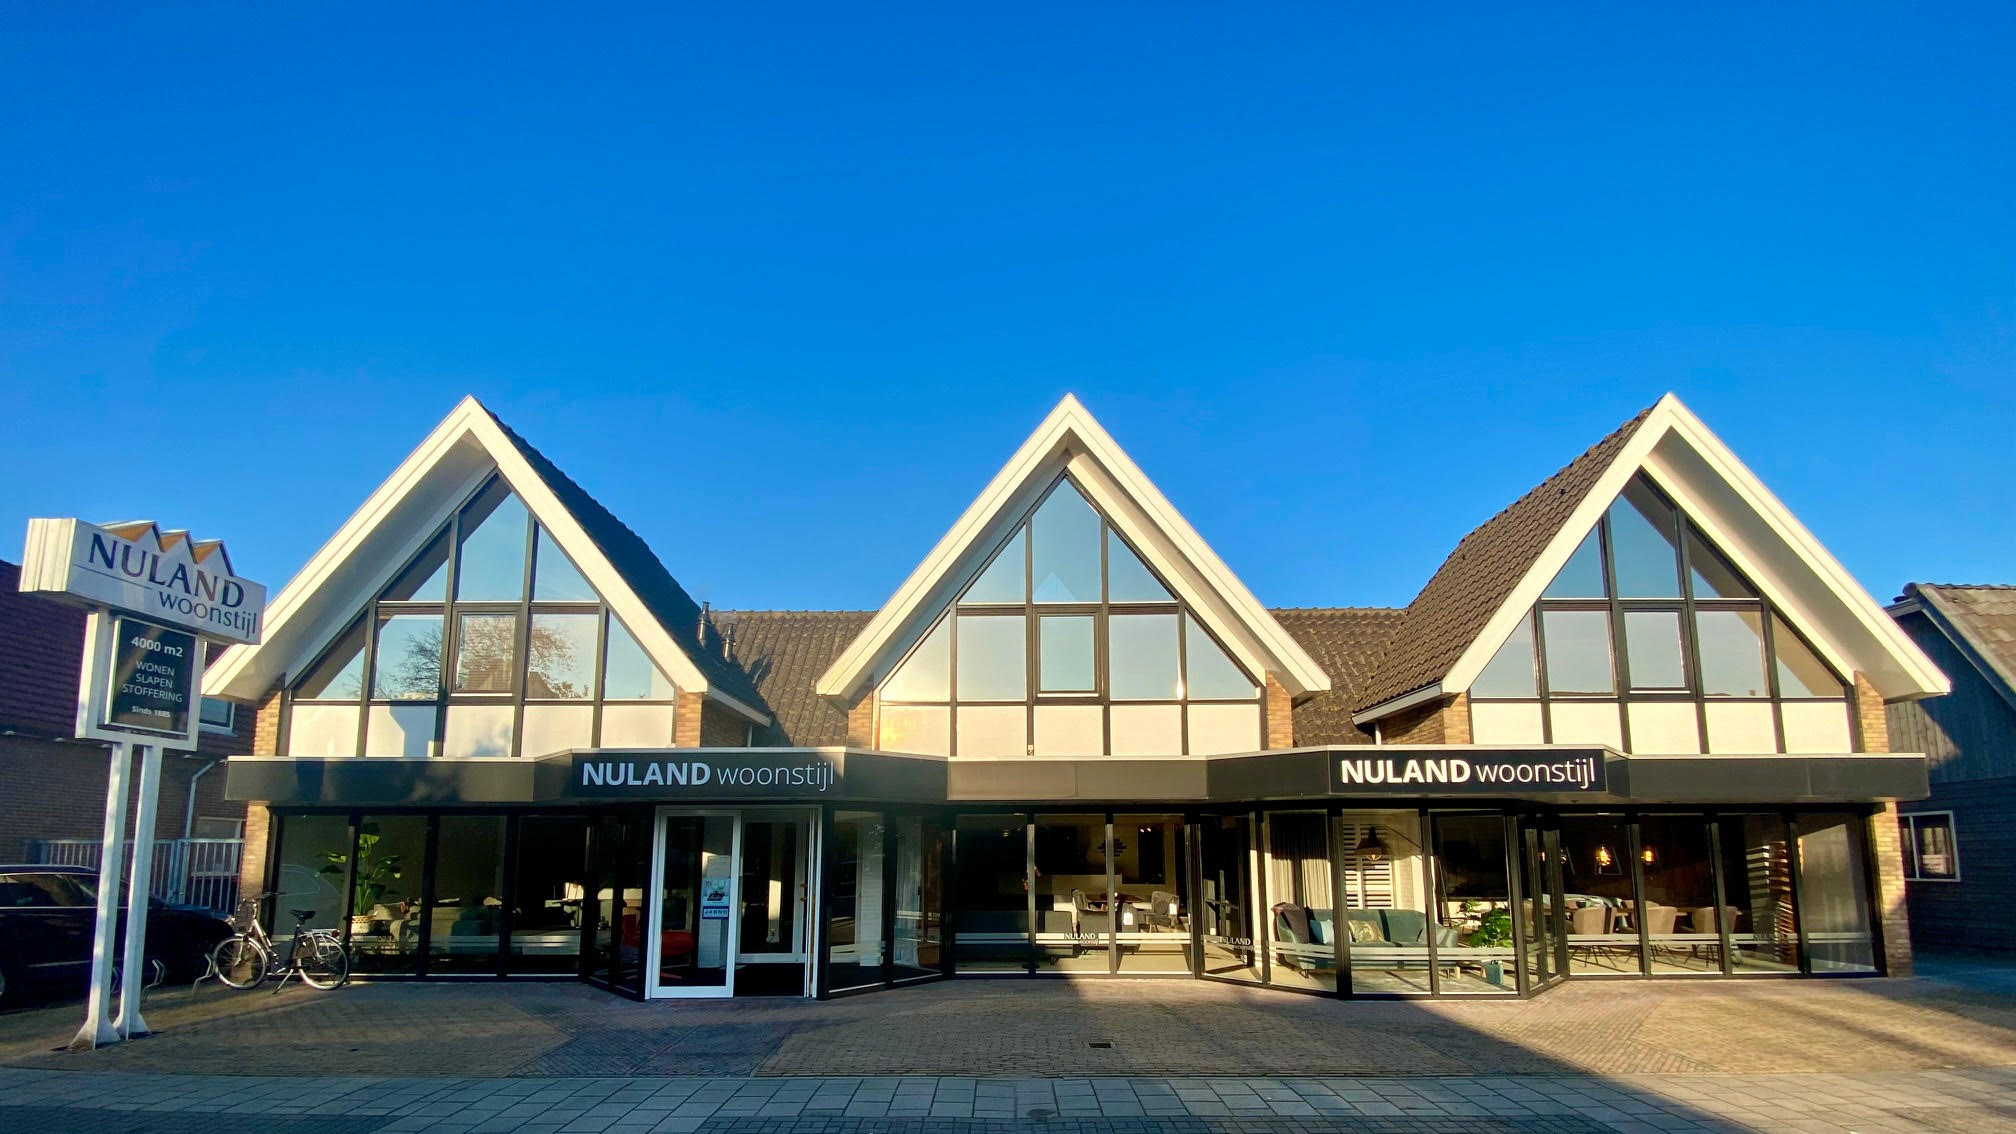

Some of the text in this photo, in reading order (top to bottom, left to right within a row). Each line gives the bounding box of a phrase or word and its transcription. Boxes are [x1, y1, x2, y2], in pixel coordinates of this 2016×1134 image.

[89, 532, 245, 609] NULAND
[158, 590, 258, 638] woonstijl
[131, 636, 184, 657] 4000 m2
[136, 660, 175, 677] WONEN
[135, 673, 173, 688] SLAPEN
[122, 683, 183, 703] STOFFERING
[131, 705, 152, 715] Sinds
[582, 761, 835, 792] NULAND woonstijl
[1340, 757, 1596, 789] NULAND woonstijl
[1064, 932, 1096, 940] NULAND
